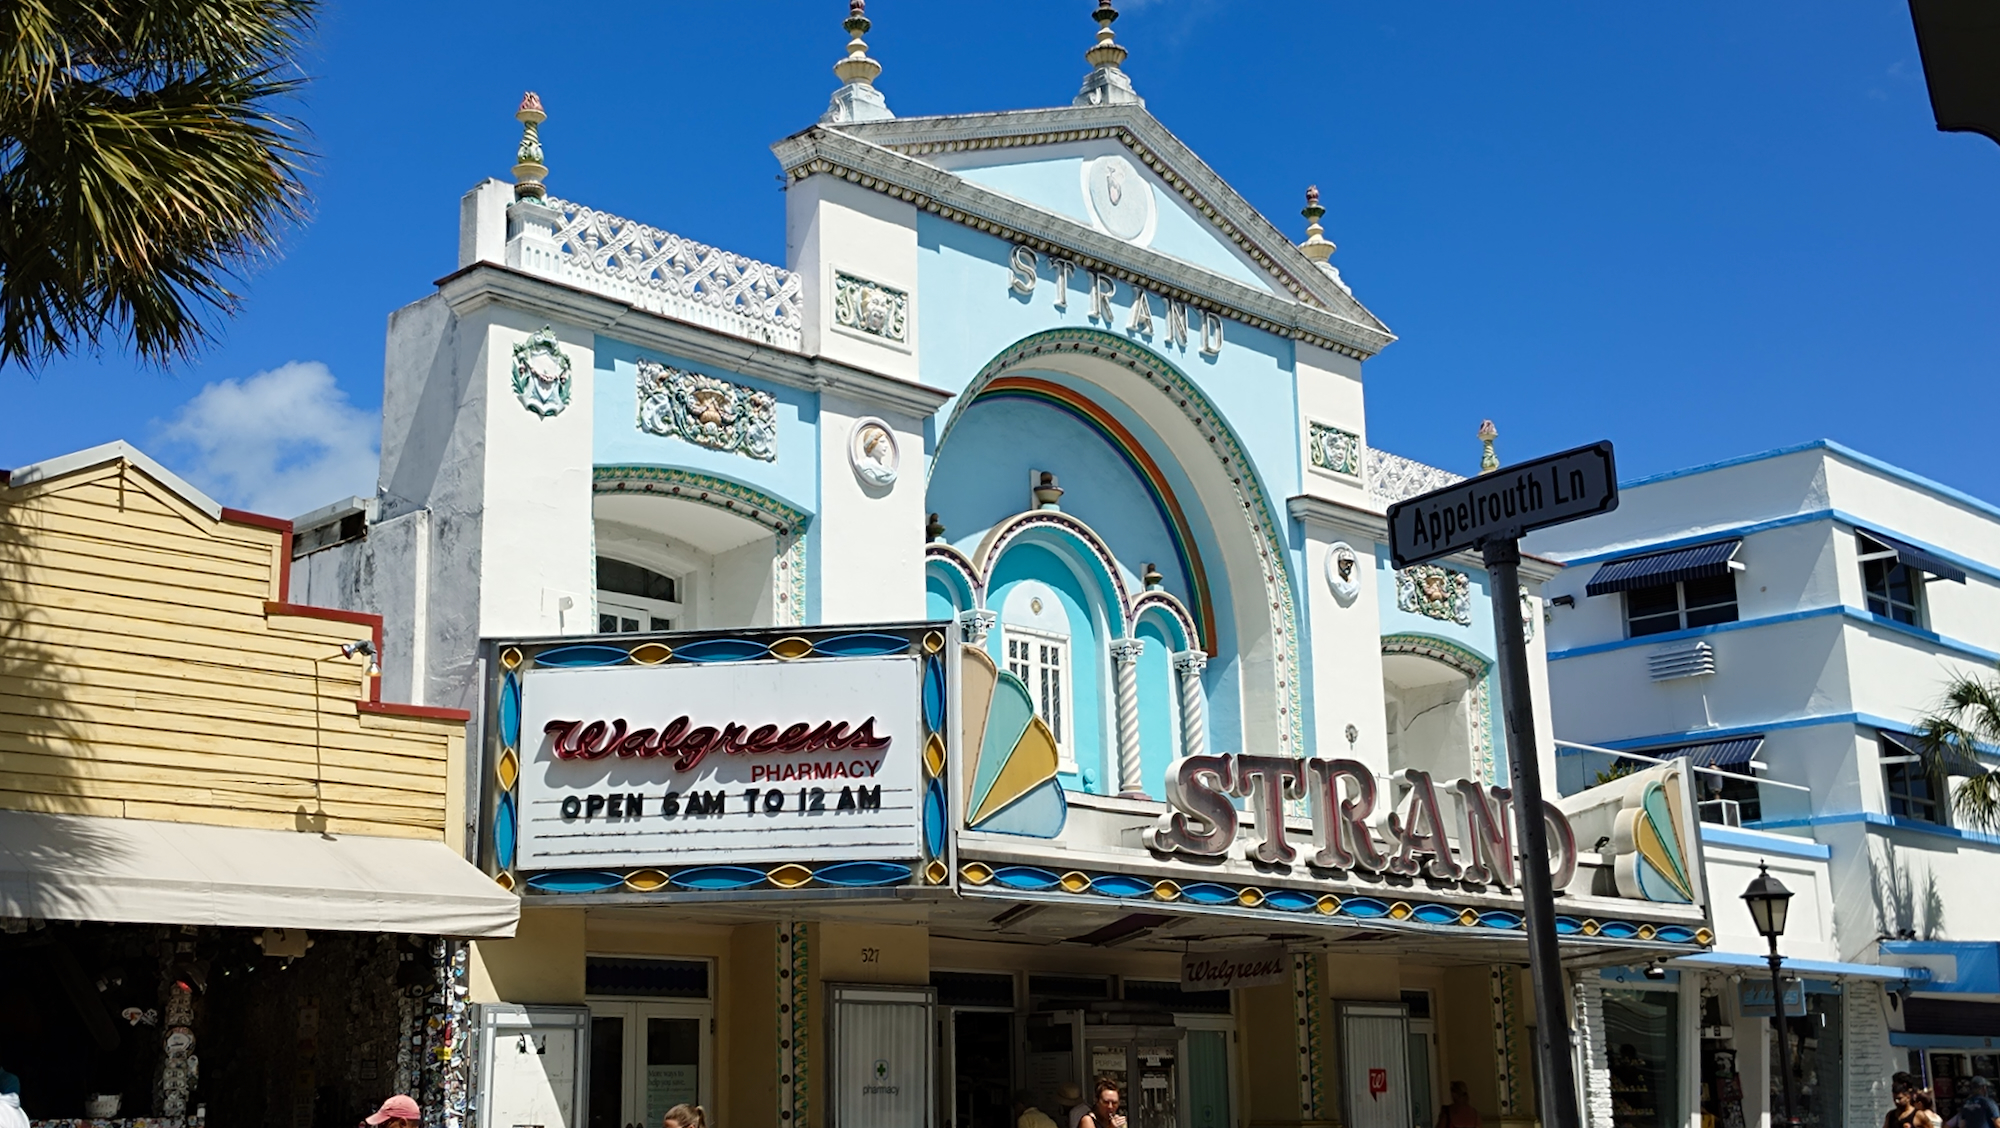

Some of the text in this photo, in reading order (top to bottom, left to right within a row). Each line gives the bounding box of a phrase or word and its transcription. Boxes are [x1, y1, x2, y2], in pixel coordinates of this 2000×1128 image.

[1008, 244, 1224, 356] STRAND
[1413, 466, 1586, 550] Appelrouth Ln
[544, 715, 893, 773] Walgreens
[751, 760, 881, 783] PHARMACY
[561, 792, 644, 819] OPEN
[743, 787, 786, 815] TO
[799, 786, 826, 814] 12
[836, 784, 882, 811] AM
[1142, 752, 1577, 890] STRAND
[861, 947, 880, 963] 527
[1185, 957, 1284, 987] Walgreens
[862, 1084, 900, 1097] pharmacy
